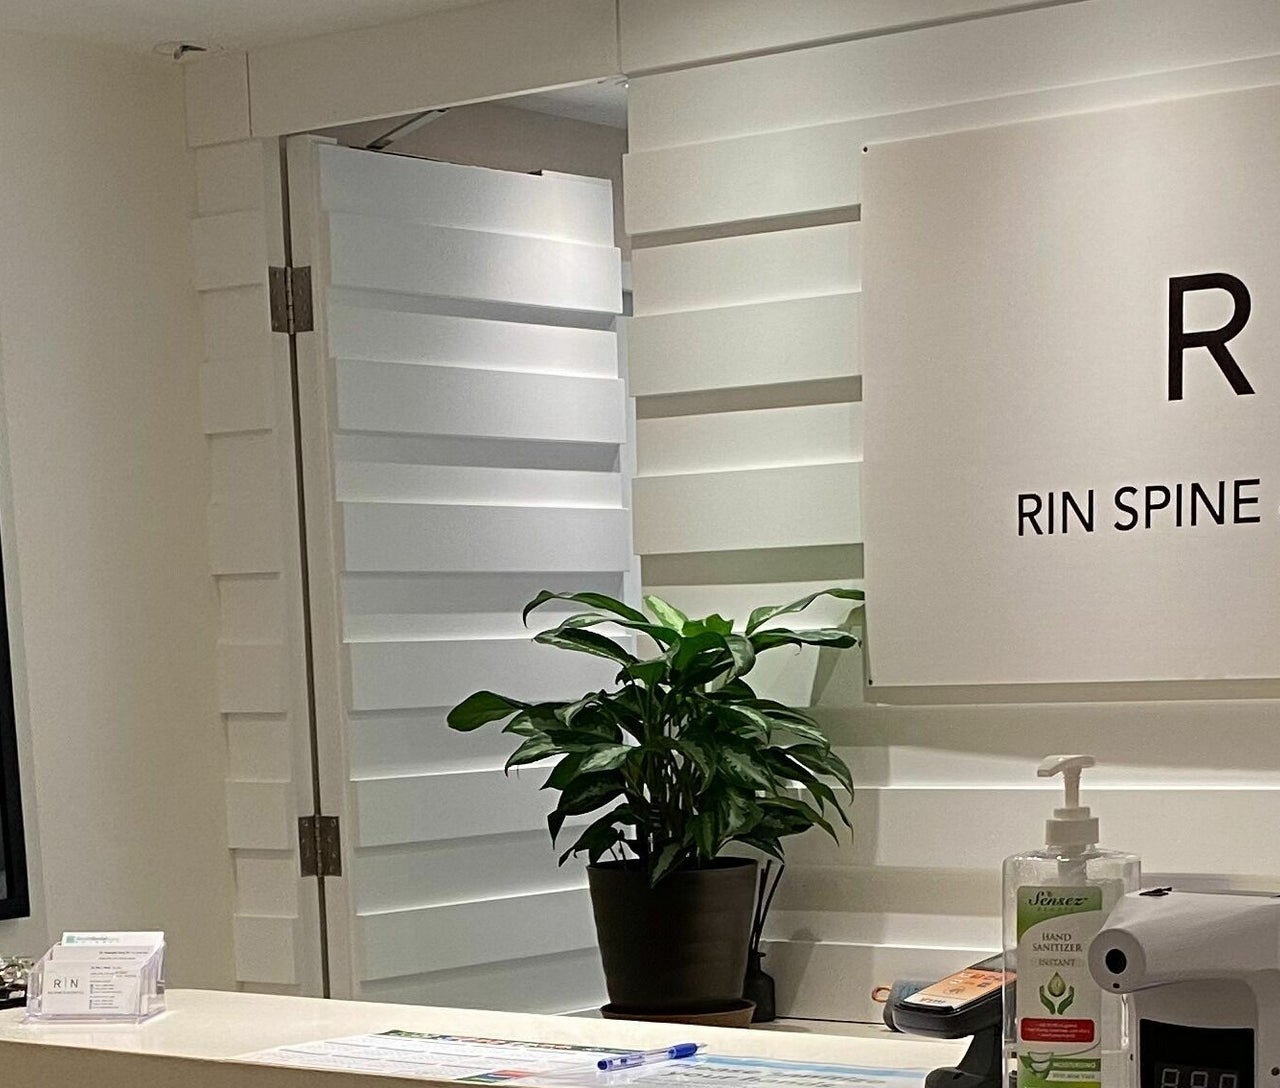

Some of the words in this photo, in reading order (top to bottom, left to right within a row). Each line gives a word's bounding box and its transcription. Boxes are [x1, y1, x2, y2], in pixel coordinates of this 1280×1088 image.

[1017, 488, 1095, 536] RIN
[1112, 477, 1261, 532] SPINE
[1041, 932, 1072, 942] HAND
[1032, 943, 1082, 952] SANITIZER
[1039, 958, 1076, 967] INSTANT
